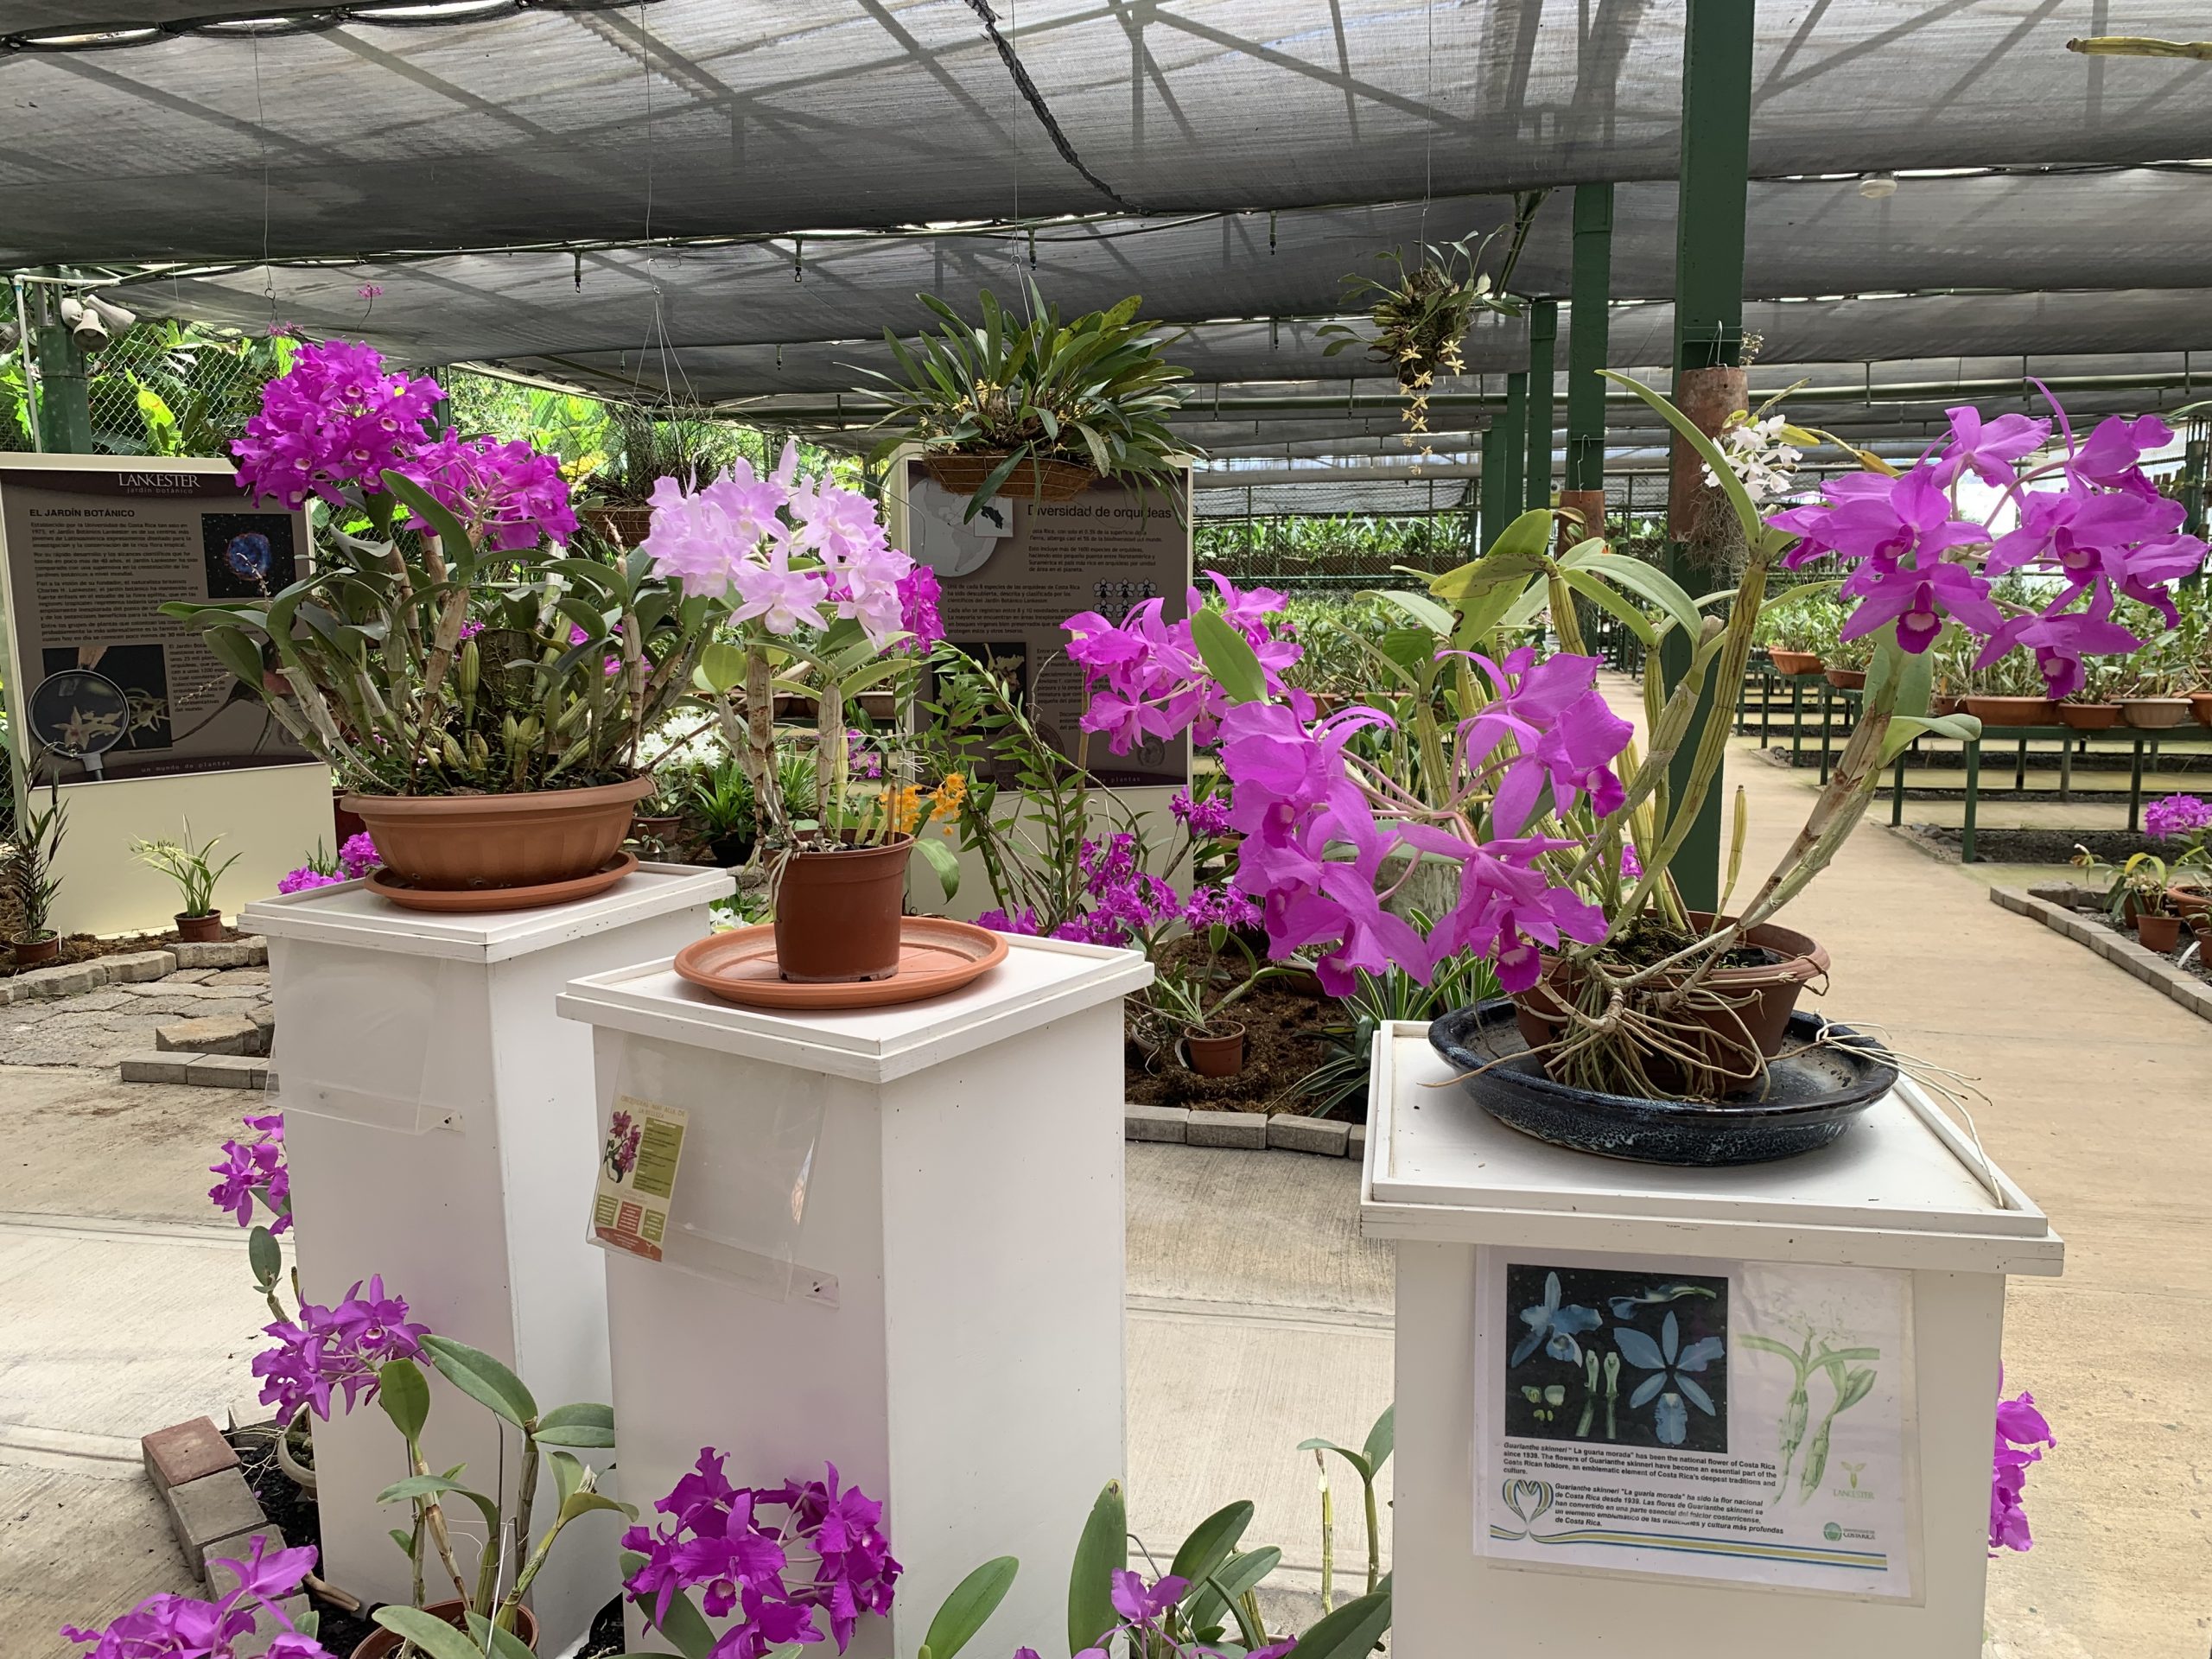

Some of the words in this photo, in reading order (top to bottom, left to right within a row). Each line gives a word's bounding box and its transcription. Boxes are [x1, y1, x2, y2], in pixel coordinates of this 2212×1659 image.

[118, 474, 201, 487] LANKESTER
[44, 507, 81, 517] JARDÍN
[84, 508, 135, 518] BOTÁNICO
[1095, 505, 1110, 518] de
[1541, 1446, 1567, 1454] skinneri
[1584, 1448, 1605, 1459] guaria
[1605, 1451, 1634, 1459] morada"
[1649, 1453, 1666, 1462] been
[1680, 1456, 1707, 1465] national
[1523, 1452, 1539, 1460] 1939.
[1555, 1454, 1580, 1463] flowers
[1589, 1458, 1625, 1467] Guarianthe
[1627, 1460, 1654, 1469] skinneri
[1673, 1464, 1699, 1472] become
[1711, 1467, 1741, 1476] essential
[1742, 1470, 1756, 1478] part
[1555, 1483, 1592, 1492] Guarianthe
[1592, 1486, 1619, 1495] skinneri
[1634, 1490, 1655, 1499] guaria
[1656, 1491, 1685, 1500] morada"
[1734, 1497, 1764, 1507] nacional
[1565, 1492, 1584, 1501] Costa
[1586, 1494, 1600, 1503] Rica
[1602, 1496, 1622, 1504] desde
[1624, 1497, 1641, 1506] 1939.
[1656, 1500, 1675, 1509] flores
[1688, 1503, 1725, 1513] Guarianthe
[1726, 1506, 1753, 1516] skinneri
[1565, 1517, 1585, 1526] Costa
